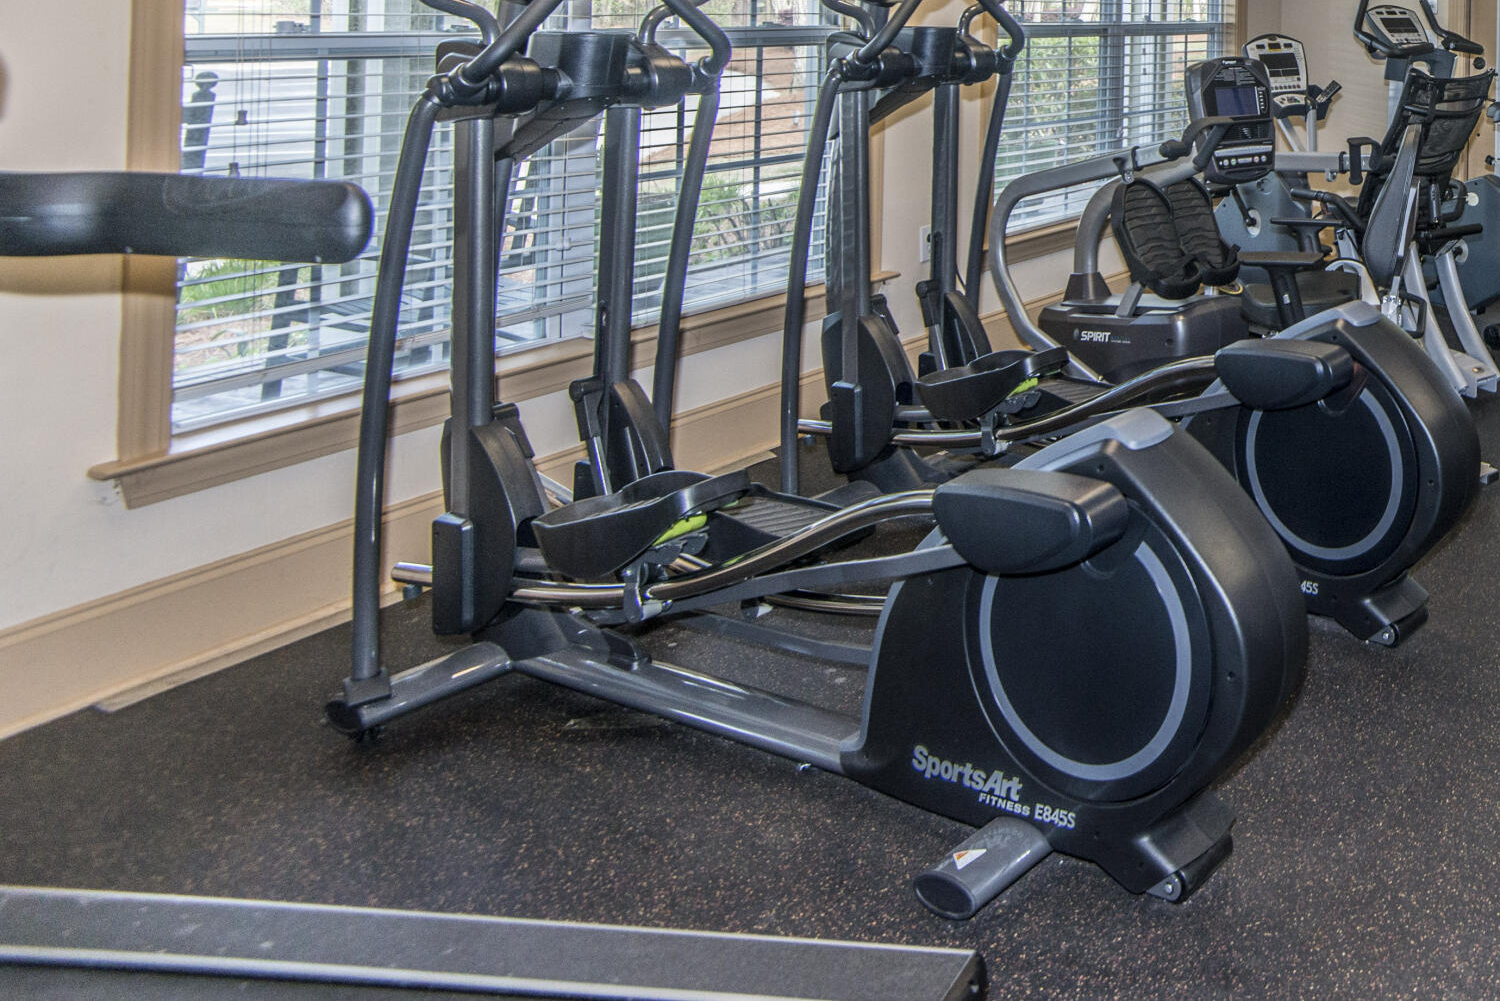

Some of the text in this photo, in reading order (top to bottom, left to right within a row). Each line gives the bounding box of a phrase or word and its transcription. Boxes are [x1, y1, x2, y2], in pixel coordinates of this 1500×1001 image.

[1080, 330, 1111, 343] SPIRIT
[1300, 580, 1319, 595] 45S
[911, 744, 1023, 802] SportsArt
[978, 792, 1077, 830] FITNESS E845S
